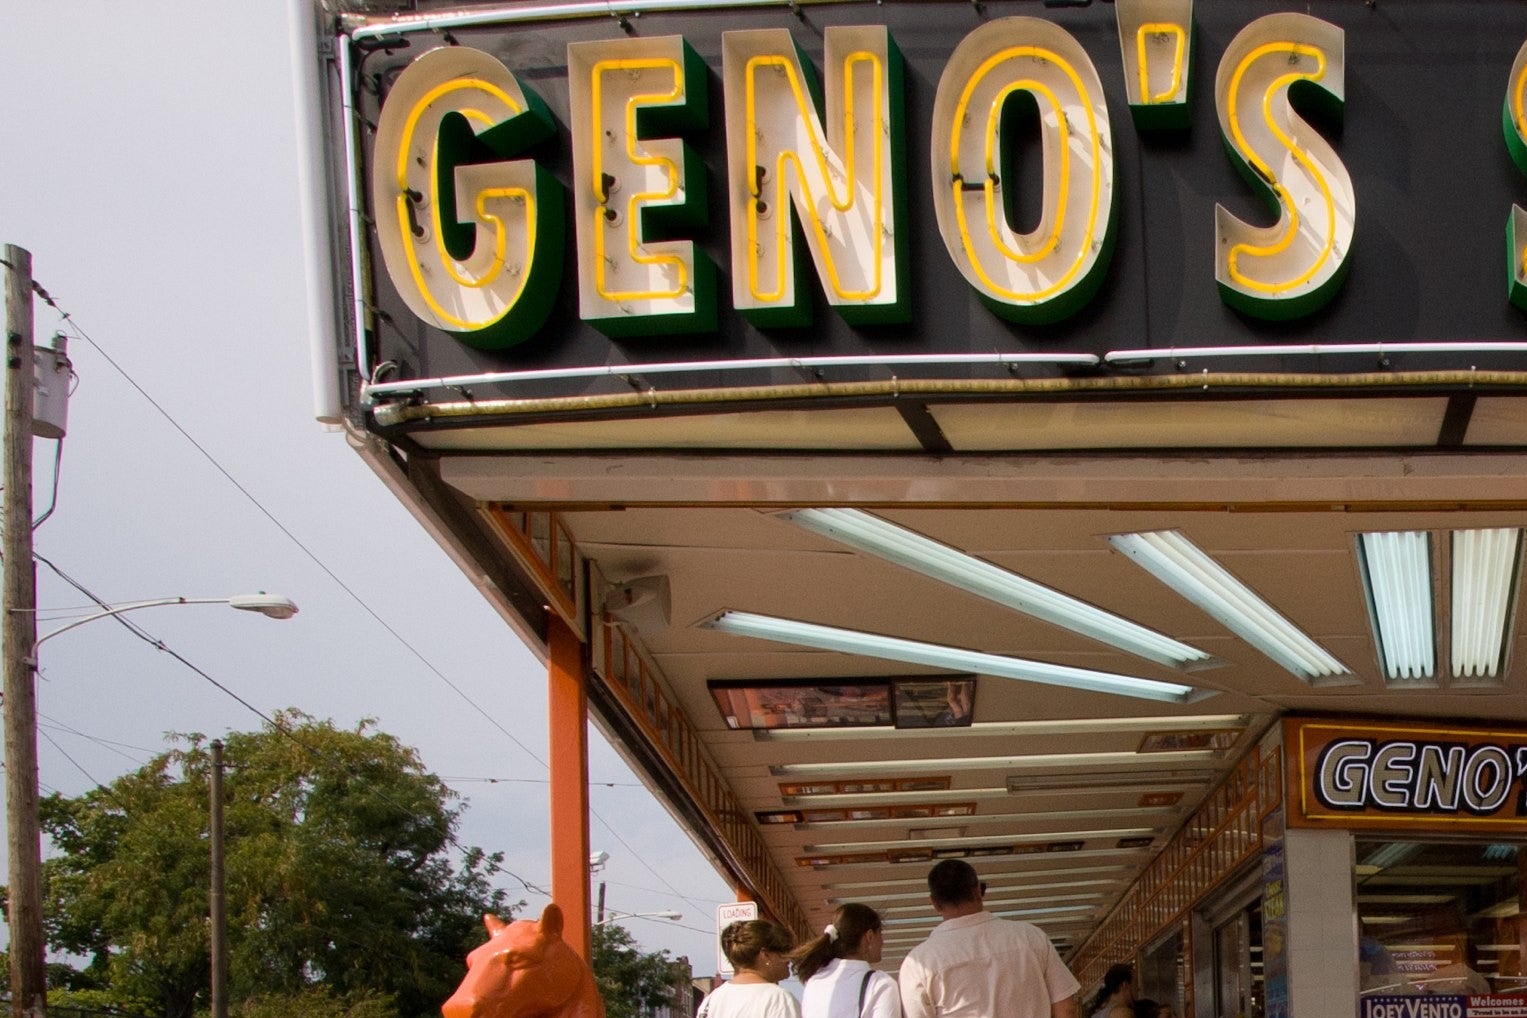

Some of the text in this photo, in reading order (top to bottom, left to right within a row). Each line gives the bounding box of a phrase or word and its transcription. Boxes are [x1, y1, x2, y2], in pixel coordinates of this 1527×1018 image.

[375, 0, 1355, 345] GENO'S
[722, 908, 752, 919] LOADING
[1471, 997, 1524, 1006] Welcomes
